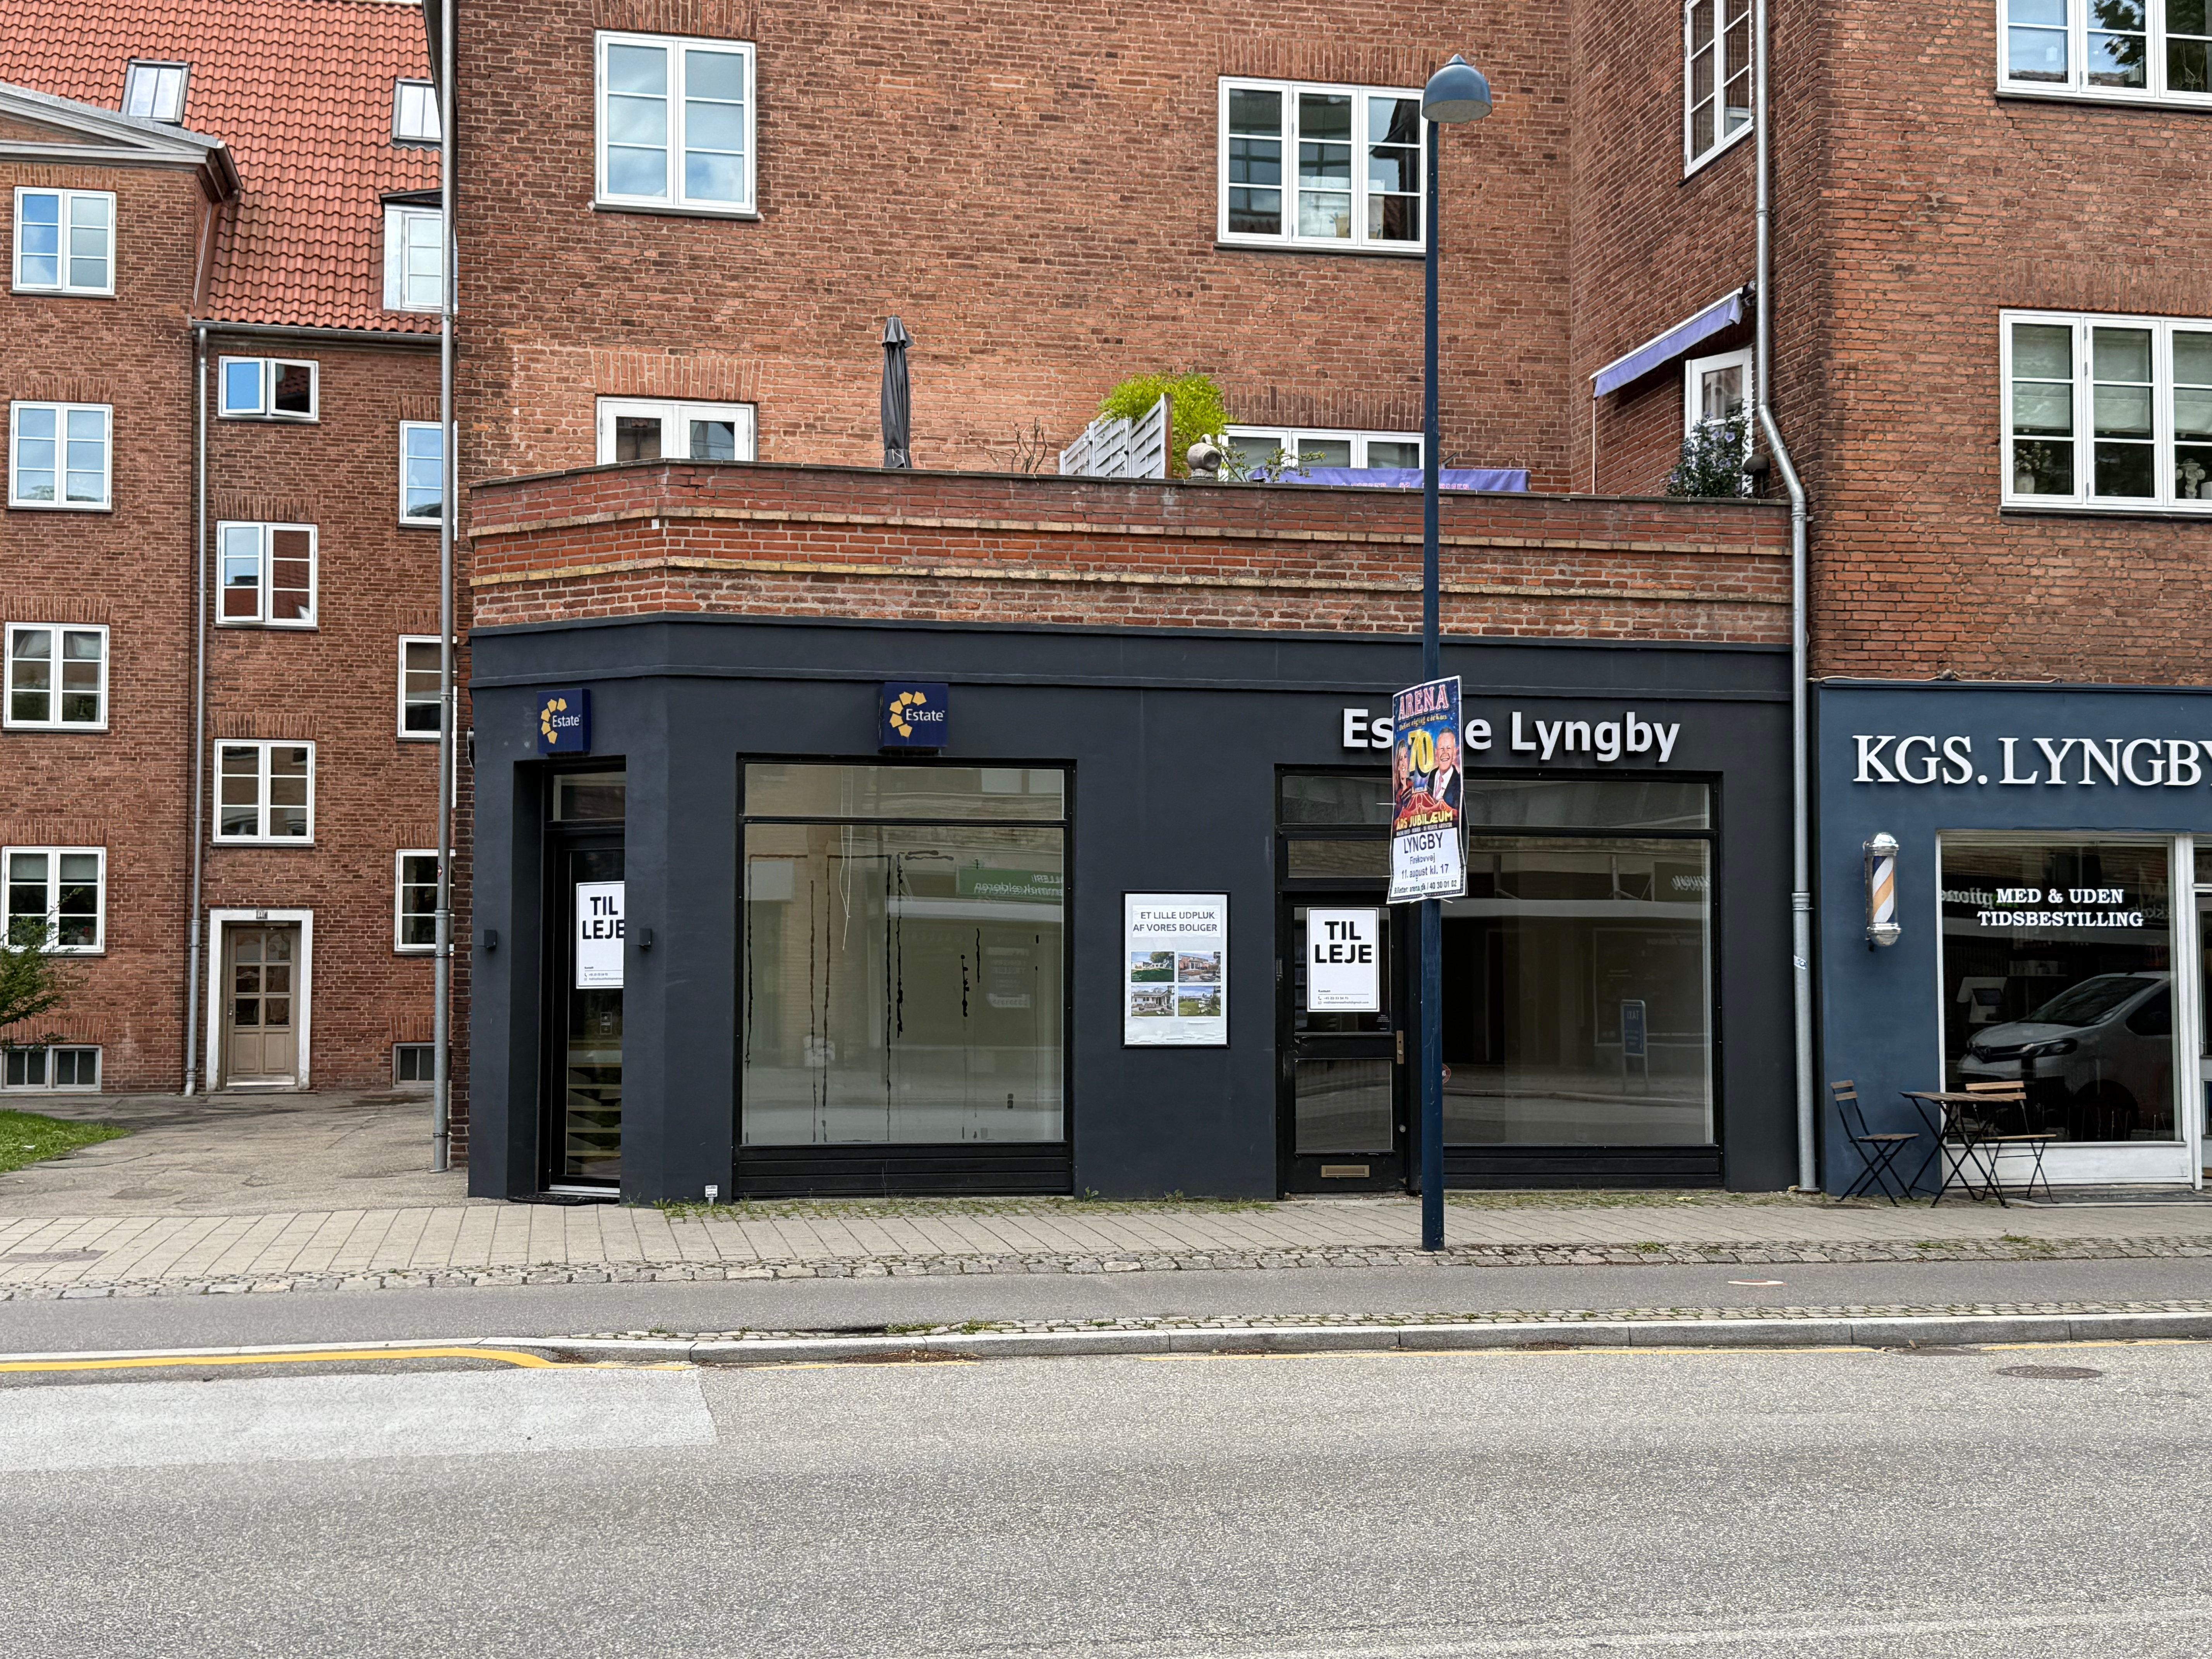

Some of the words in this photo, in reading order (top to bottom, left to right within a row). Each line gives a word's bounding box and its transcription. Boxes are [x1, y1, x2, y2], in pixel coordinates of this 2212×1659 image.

[1398, 684, 1449, 720] ARENA
[552, 714, 579, 728] Estate
[906, 708, 944, 722] Estate
[1343, 708, 1492, 750] Ese
[1511, 711, 1680, 763] Lyngby
[1408, 728, 1434, 776] 70
[1853, 735, 1988, 785] KGS.
[1409, 810, 1453, 828] JUBILÆUM
[1404, 832, 1443, 854] LYNGBY
[1410, 866, 1428, 879] august
[1430, 865, 1438, 875] kl.
[1440, 864, 1449, 874] 17
[1996, 888, 2041, 903] MED
[2048, 889, 2063, 903] &
[2068, 888, 2124, 904] UDEN
[589, 896, 618, 916] TIL
[1179, 911, 1216, 919] UDPLUK
[1179, 924, 1218, 932] BOLIGER
[1978, 910, 2144, 927] TIDSBESTILLING
[582, 919, 625, 940] LEJE
[1324, 921, 1362, 940] TIL
[1315, 944, 1372, 963] LEJE
